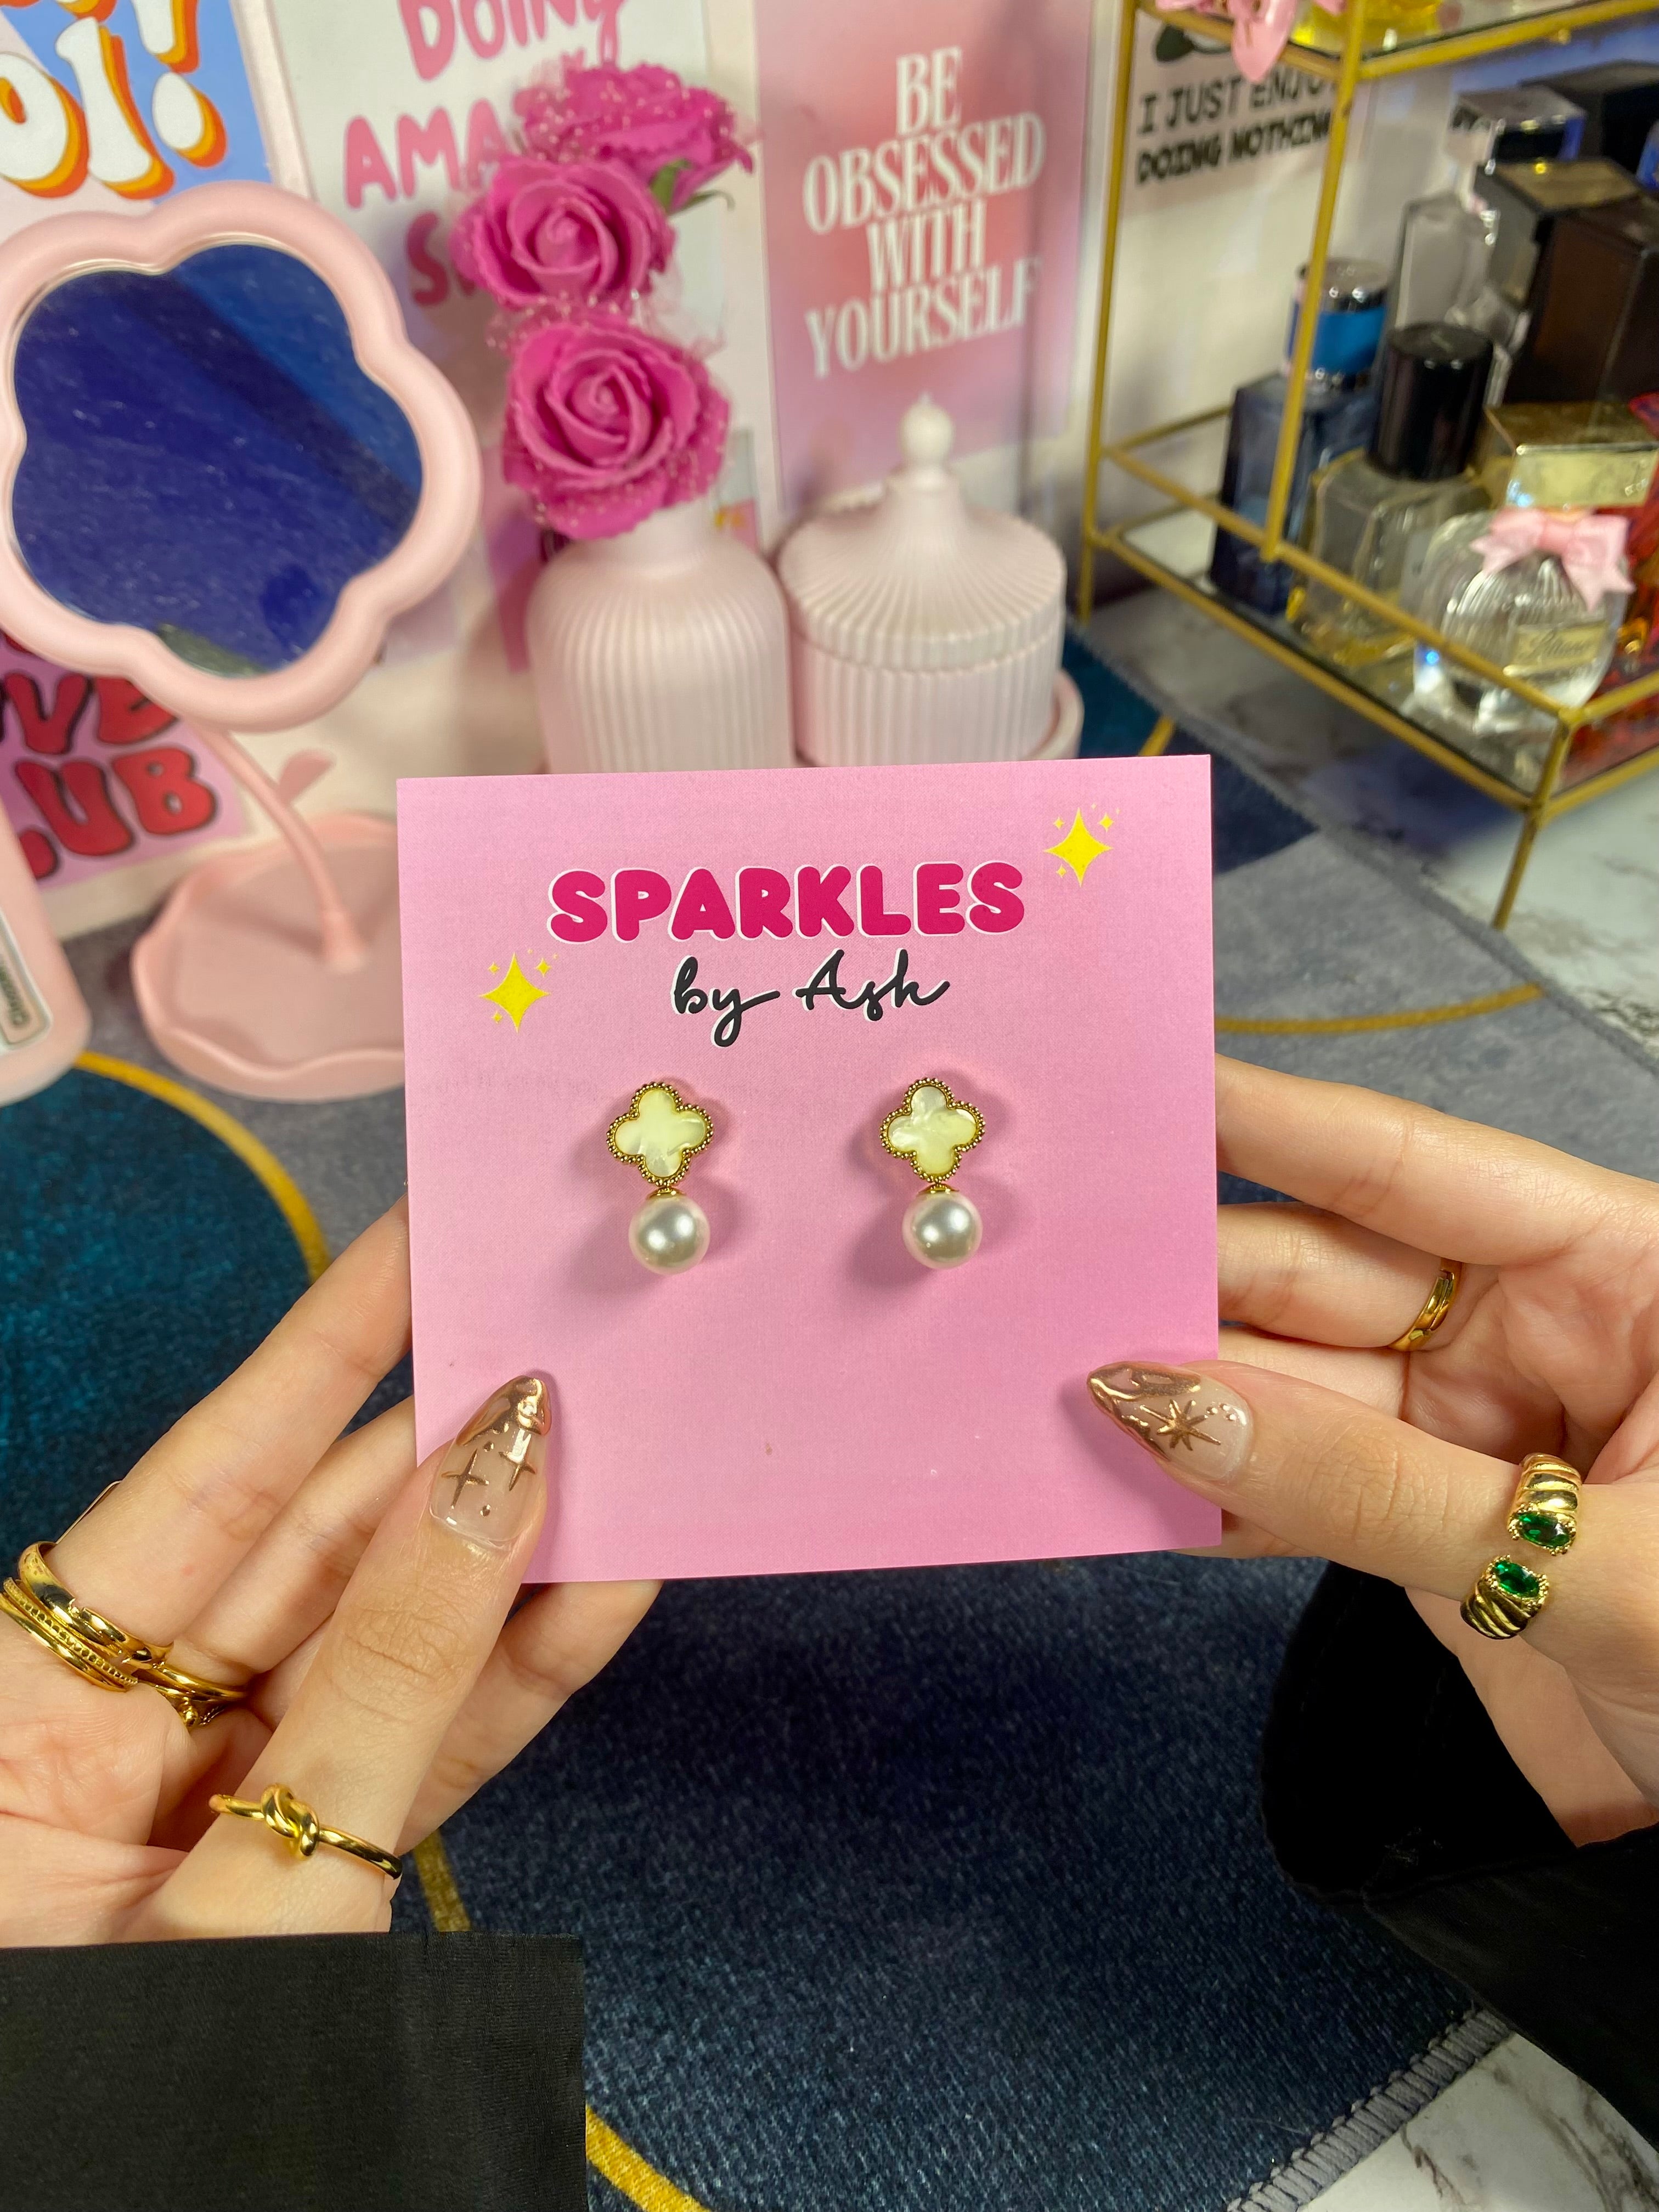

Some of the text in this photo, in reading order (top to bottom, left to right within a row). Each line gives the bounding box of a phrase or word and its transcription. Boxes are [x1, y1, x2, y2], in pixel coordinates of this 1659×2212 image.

[896, 45, 963, 136] BE
[1137, 66, 1337, 134] I JUST ENJO
[802, 112, 1045, 235] OBSESSED
[1135, 109, 1331, 184] DOING NOTHIN
[867, 199, 986, 292] WITH
[804, 255, 1042, 379] YOURSELF
[0, 672, 181, 755] VE
[546, 860, 1025, 944] SPARKLES
[670, 948, 951, 1048] by Ash
